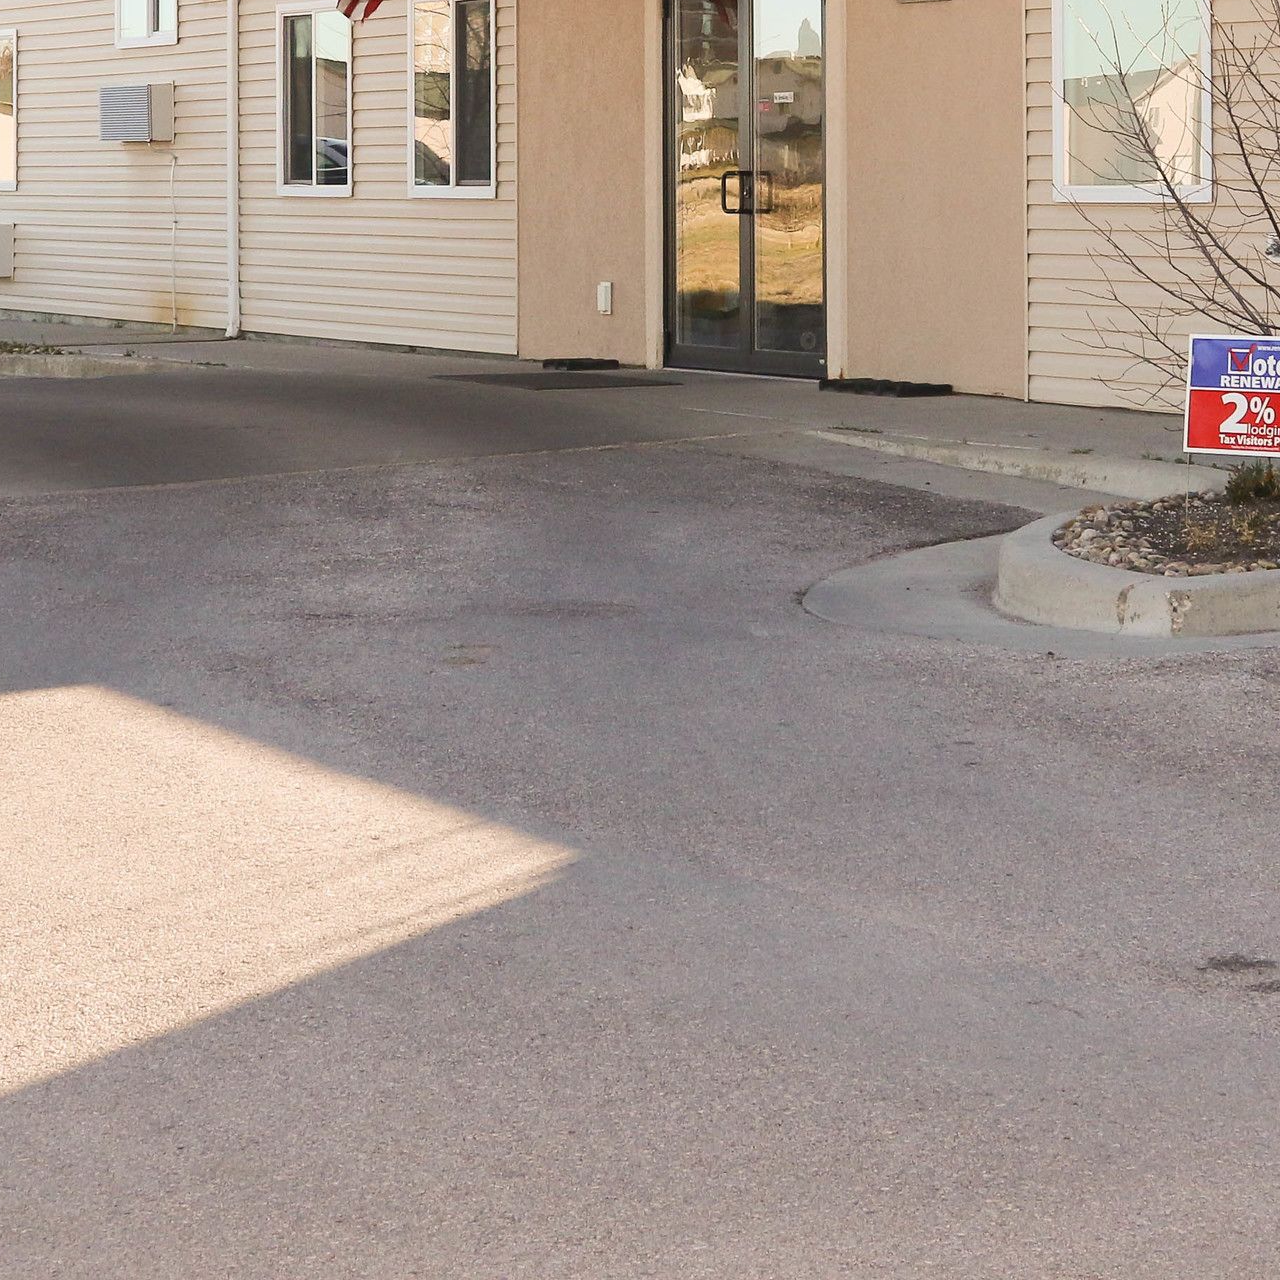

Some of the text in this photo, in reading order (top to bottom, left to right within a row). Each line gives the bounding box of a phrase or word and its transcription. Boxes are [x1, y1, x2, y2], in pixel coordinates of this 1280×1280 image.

[1220, 392, 1275, 434] 2%
[1219, 434, 1236, 445] Tax
[1237, 435, 1273, 447] Visitors
